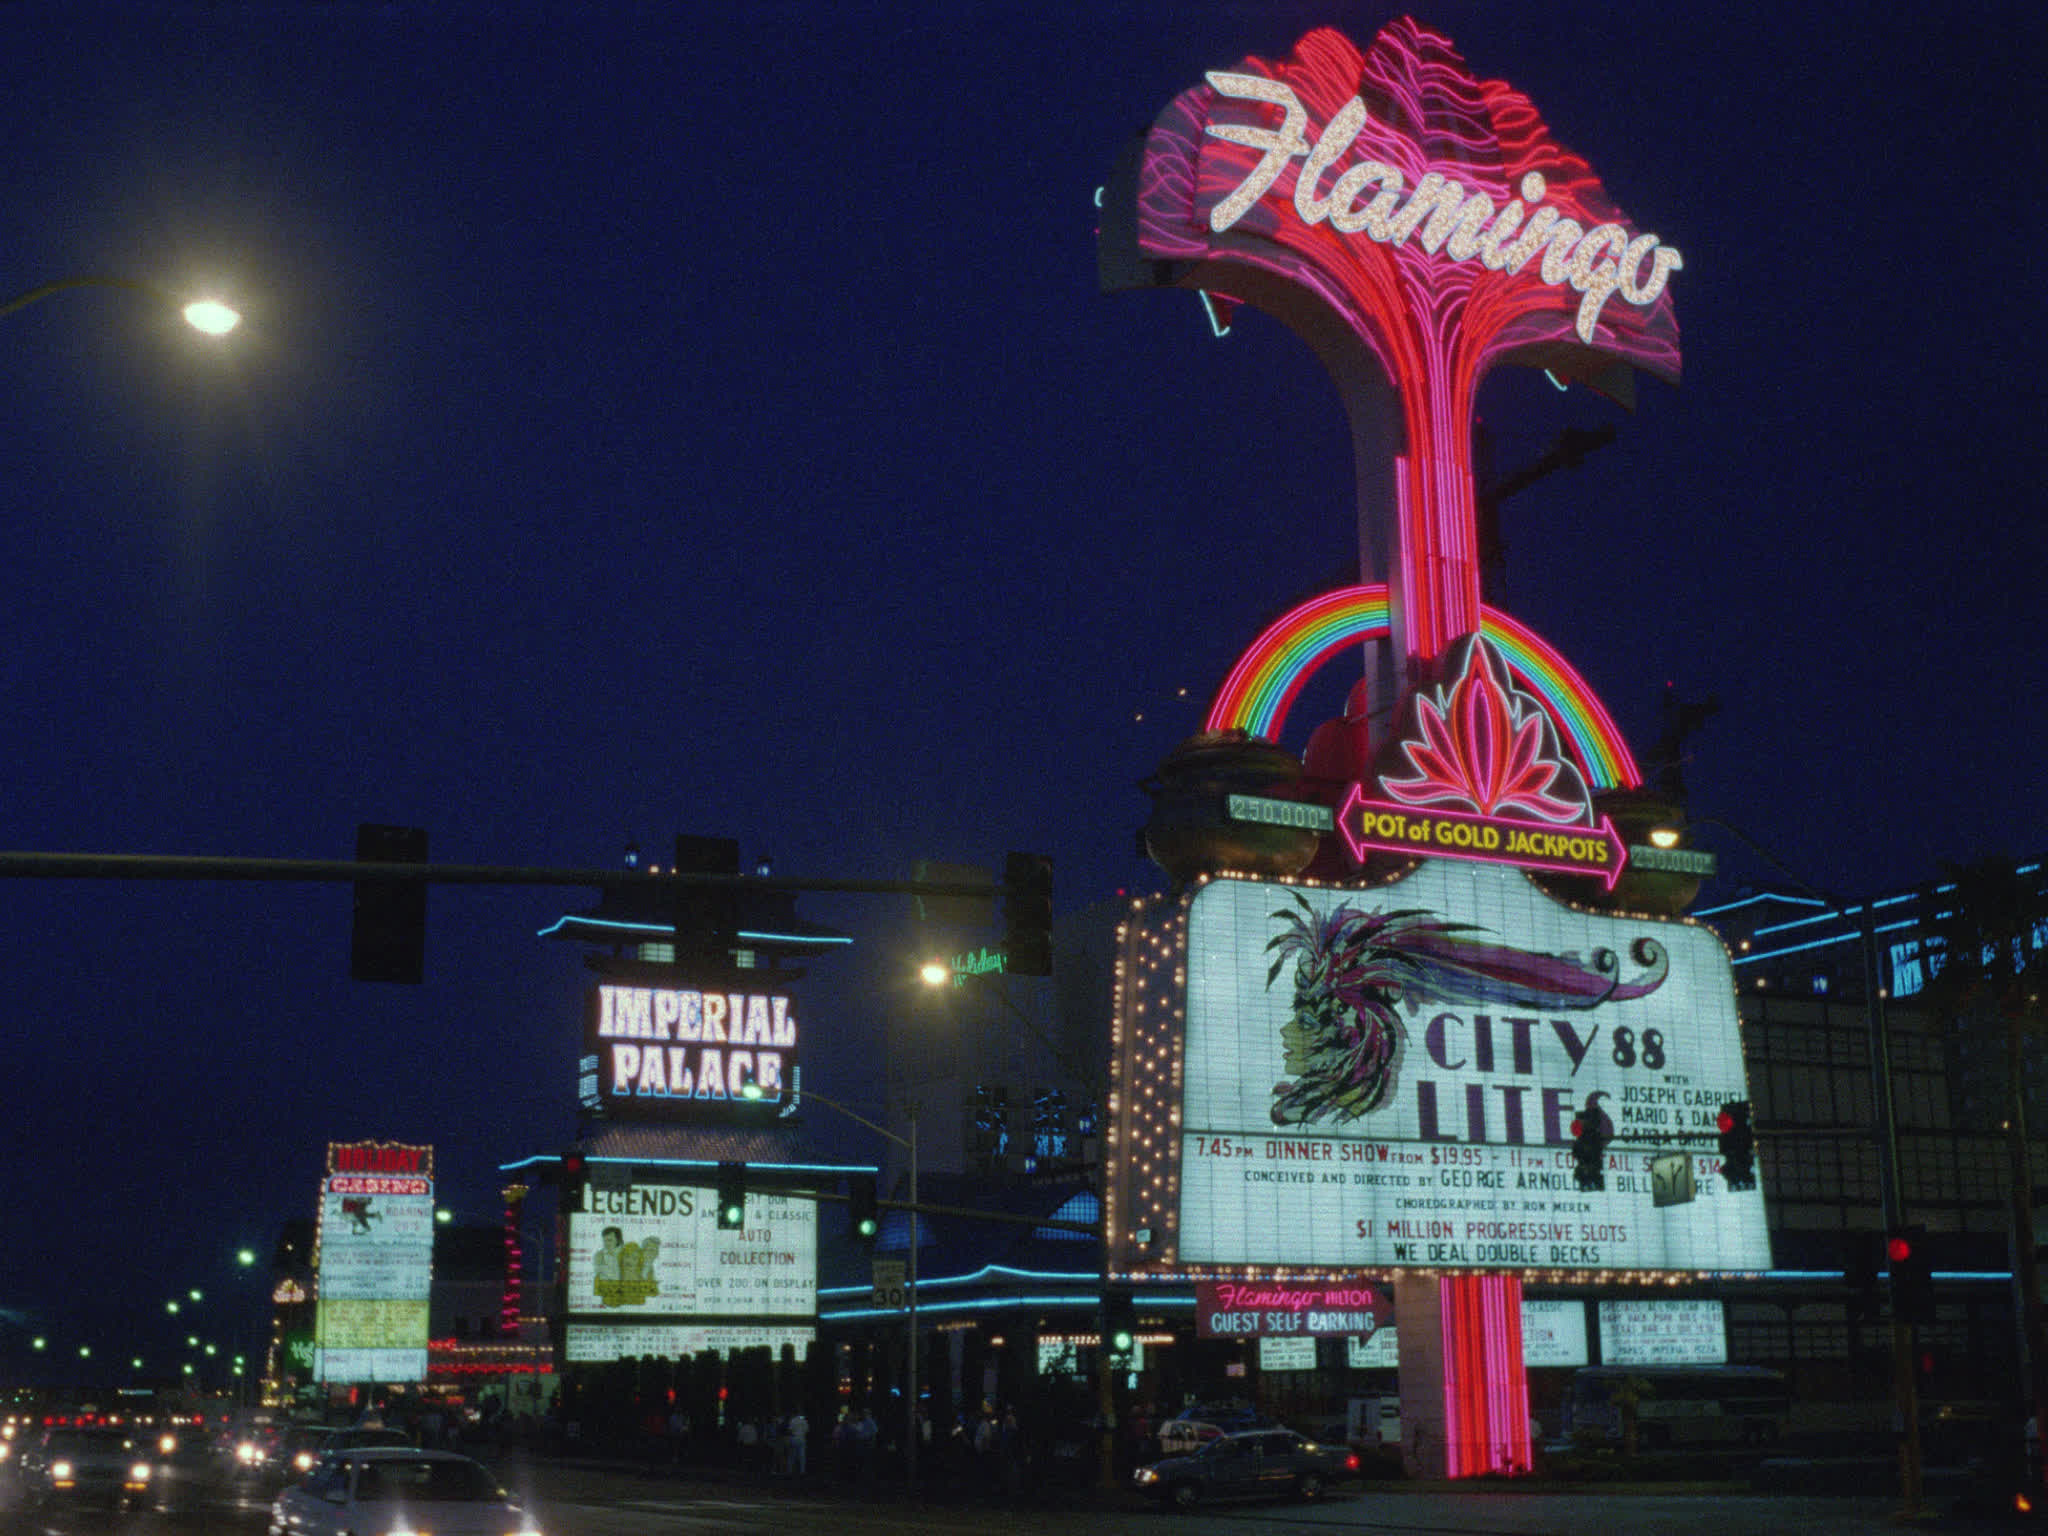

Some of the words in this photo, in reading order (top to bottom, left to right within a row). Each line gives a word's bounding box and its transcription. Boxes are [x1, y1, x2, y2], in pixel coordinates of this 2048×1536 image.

[1205, 71, 1683, 344] Flamingo
[1363, 812, 1406, 838] POT
[1408, 820, 1431, 841] of
[1435, 822, 1499, 849] GOLD
[1506, 831, 1608, 862] JACKPOTS
[599, 985, 796, 1046] IMPERIAL
[1425, 1013, 1598, 1076] CITY
[1612, 1026, 1665, 1070] 88
[612, 1044, 782, 1103] PALACE
[1621, 1086, 1675, 1104] JOSEPH
[1622, 1106, 1667, 1124] MARIO
[1675, 1109, 1684, 1126] &
[337, 1148, 423, 1172] HOLIDAY
[1235, 1147, 1253, 1157] PM
[1266, 1140, 1332, 1160] DINNER
[1340, 1143, 1389, 1162] SHOW
[1391, 1152, 1423, 1164] FROM
[1431, 1146, 1482, 1166] $19.95
[1244, 1169, 1314, 1184] CONCEIVED
[1322, 1172, 1346, 1184] AND
[1354, 1173, 1410, 1186] DIRECTED
[1419, 1177, 1432, 1187] BY
[1441, 1168, 1505, 1189] GEORGE
[1617, 1175, 1650, 1193] BILL
[768, 1209, 812, 1221] CLASSIC
[1395, 1198, 1496, 1210] CHOREOGRAPHED
[738, 1228, 772, 1242] AUTO
[1356, 1219, 1373, 1238] $1
[1388, 1219, 1453, 1239] MILLION
[1467, 1221, 1573, 1242] PROGRESSIVE
[1581, 1224, 1627, 1243] SLOTS
[720, 1251, 795, 1265] COLLECTION
[1395, 1243, 1417, 1261] WE
[1428, 1243, 1469, 1262] DEAL
[1477, 1245, 1537, 1263] DOUBLE
[1550, 1246, 1600, 1264] DECKS
[753, 1278, 768, 1288] ON
[1216, 1284, 1321, 1311] Flamingo
[1325, 1290, 1372, 1306] HILTON
[1211, 1312, 1260, 1332] GUEST
[1266, 1312, 1302, 1331] SELF
[1307, 1312, 1375, 1331] PARKING
